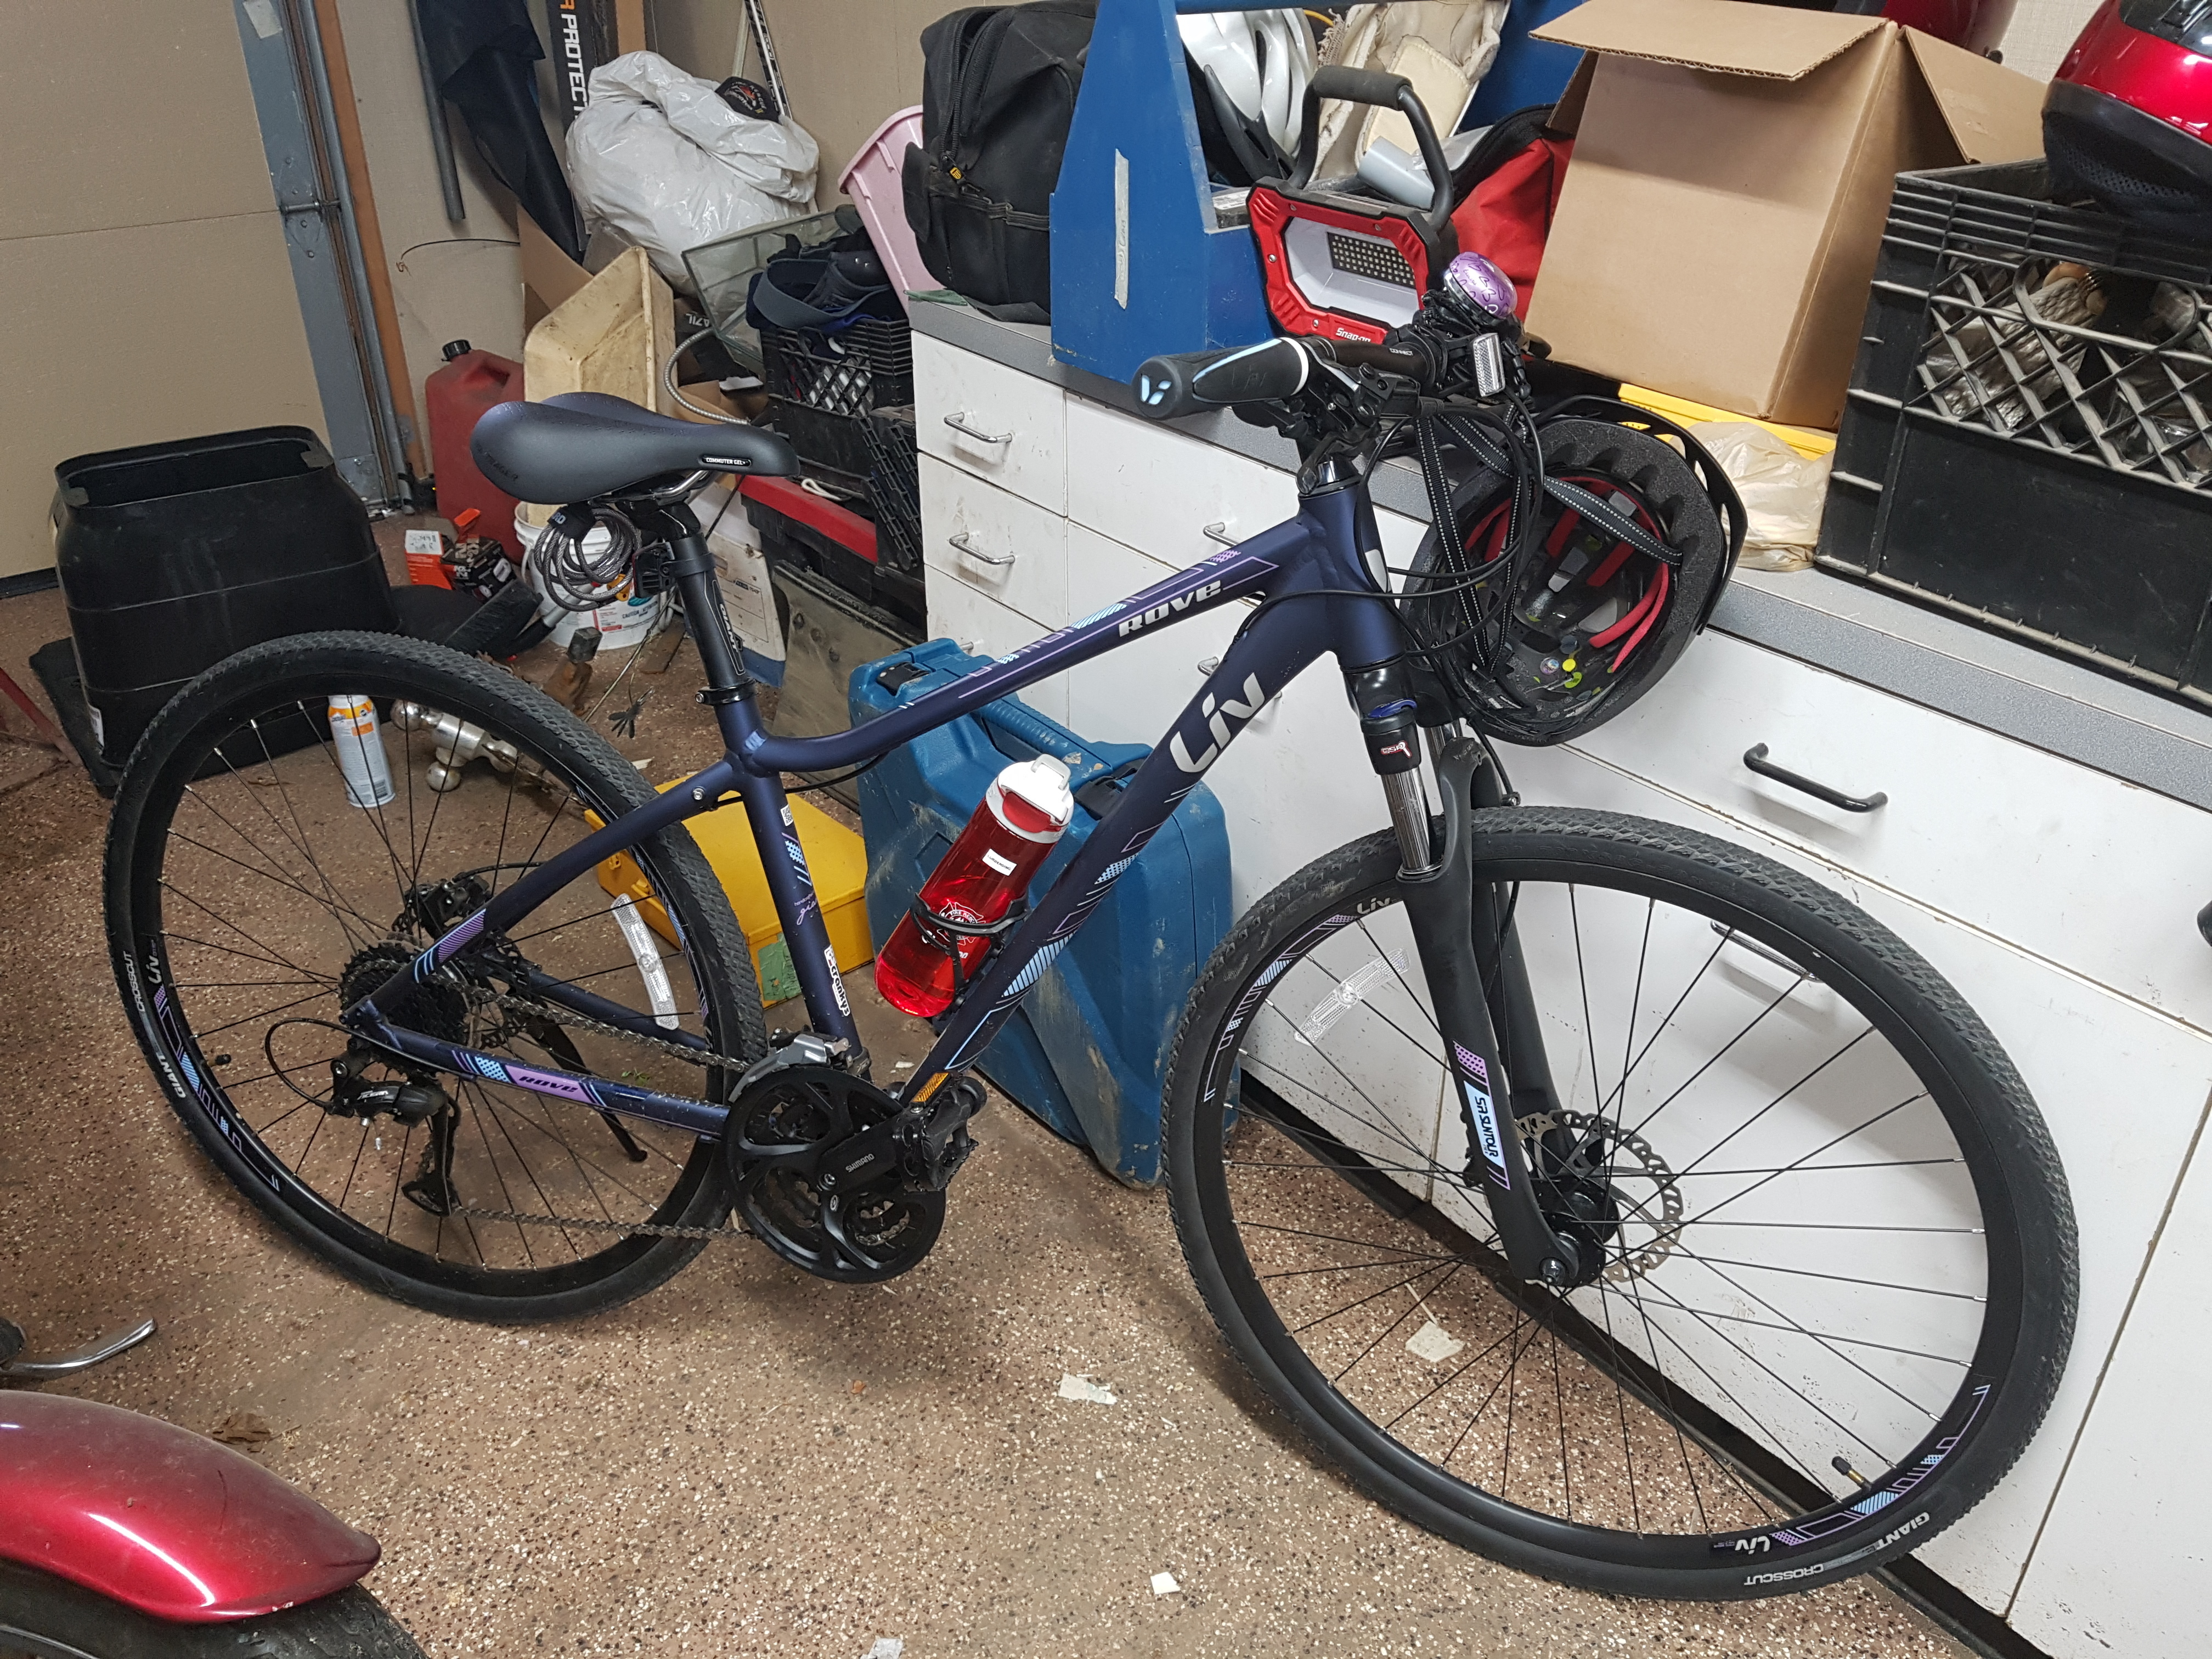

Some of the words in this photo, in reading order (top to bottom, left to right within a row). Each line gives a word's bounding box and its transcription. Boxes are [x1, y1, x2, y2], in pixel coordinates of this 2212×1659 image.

[561, 14, 589, 120] PROTECT
[685, 313, 710, 328] AZIL
[720, 603, 738, 653] GIANT
[1170, 672, 1265, 773] Liv
[1357, 897, 1391, 915] Liv
[123, 950, 145, 1012] CROSSCUT
[148, 955, 162, 984] Liv
[831, 965, 850, 1015] crankys
[157, 1055, 187, 1098] GIANT
[1479, 1114, 1499, 1157] SUNTOUR
[845, 1153, 876, 1173] SHIMANO
[1734, 1536, 1771, 1555] Liv
[1876, 1511, 1931, 1550] GIANT
[1743, 1563, 1824, 1586] CROSSCUT
